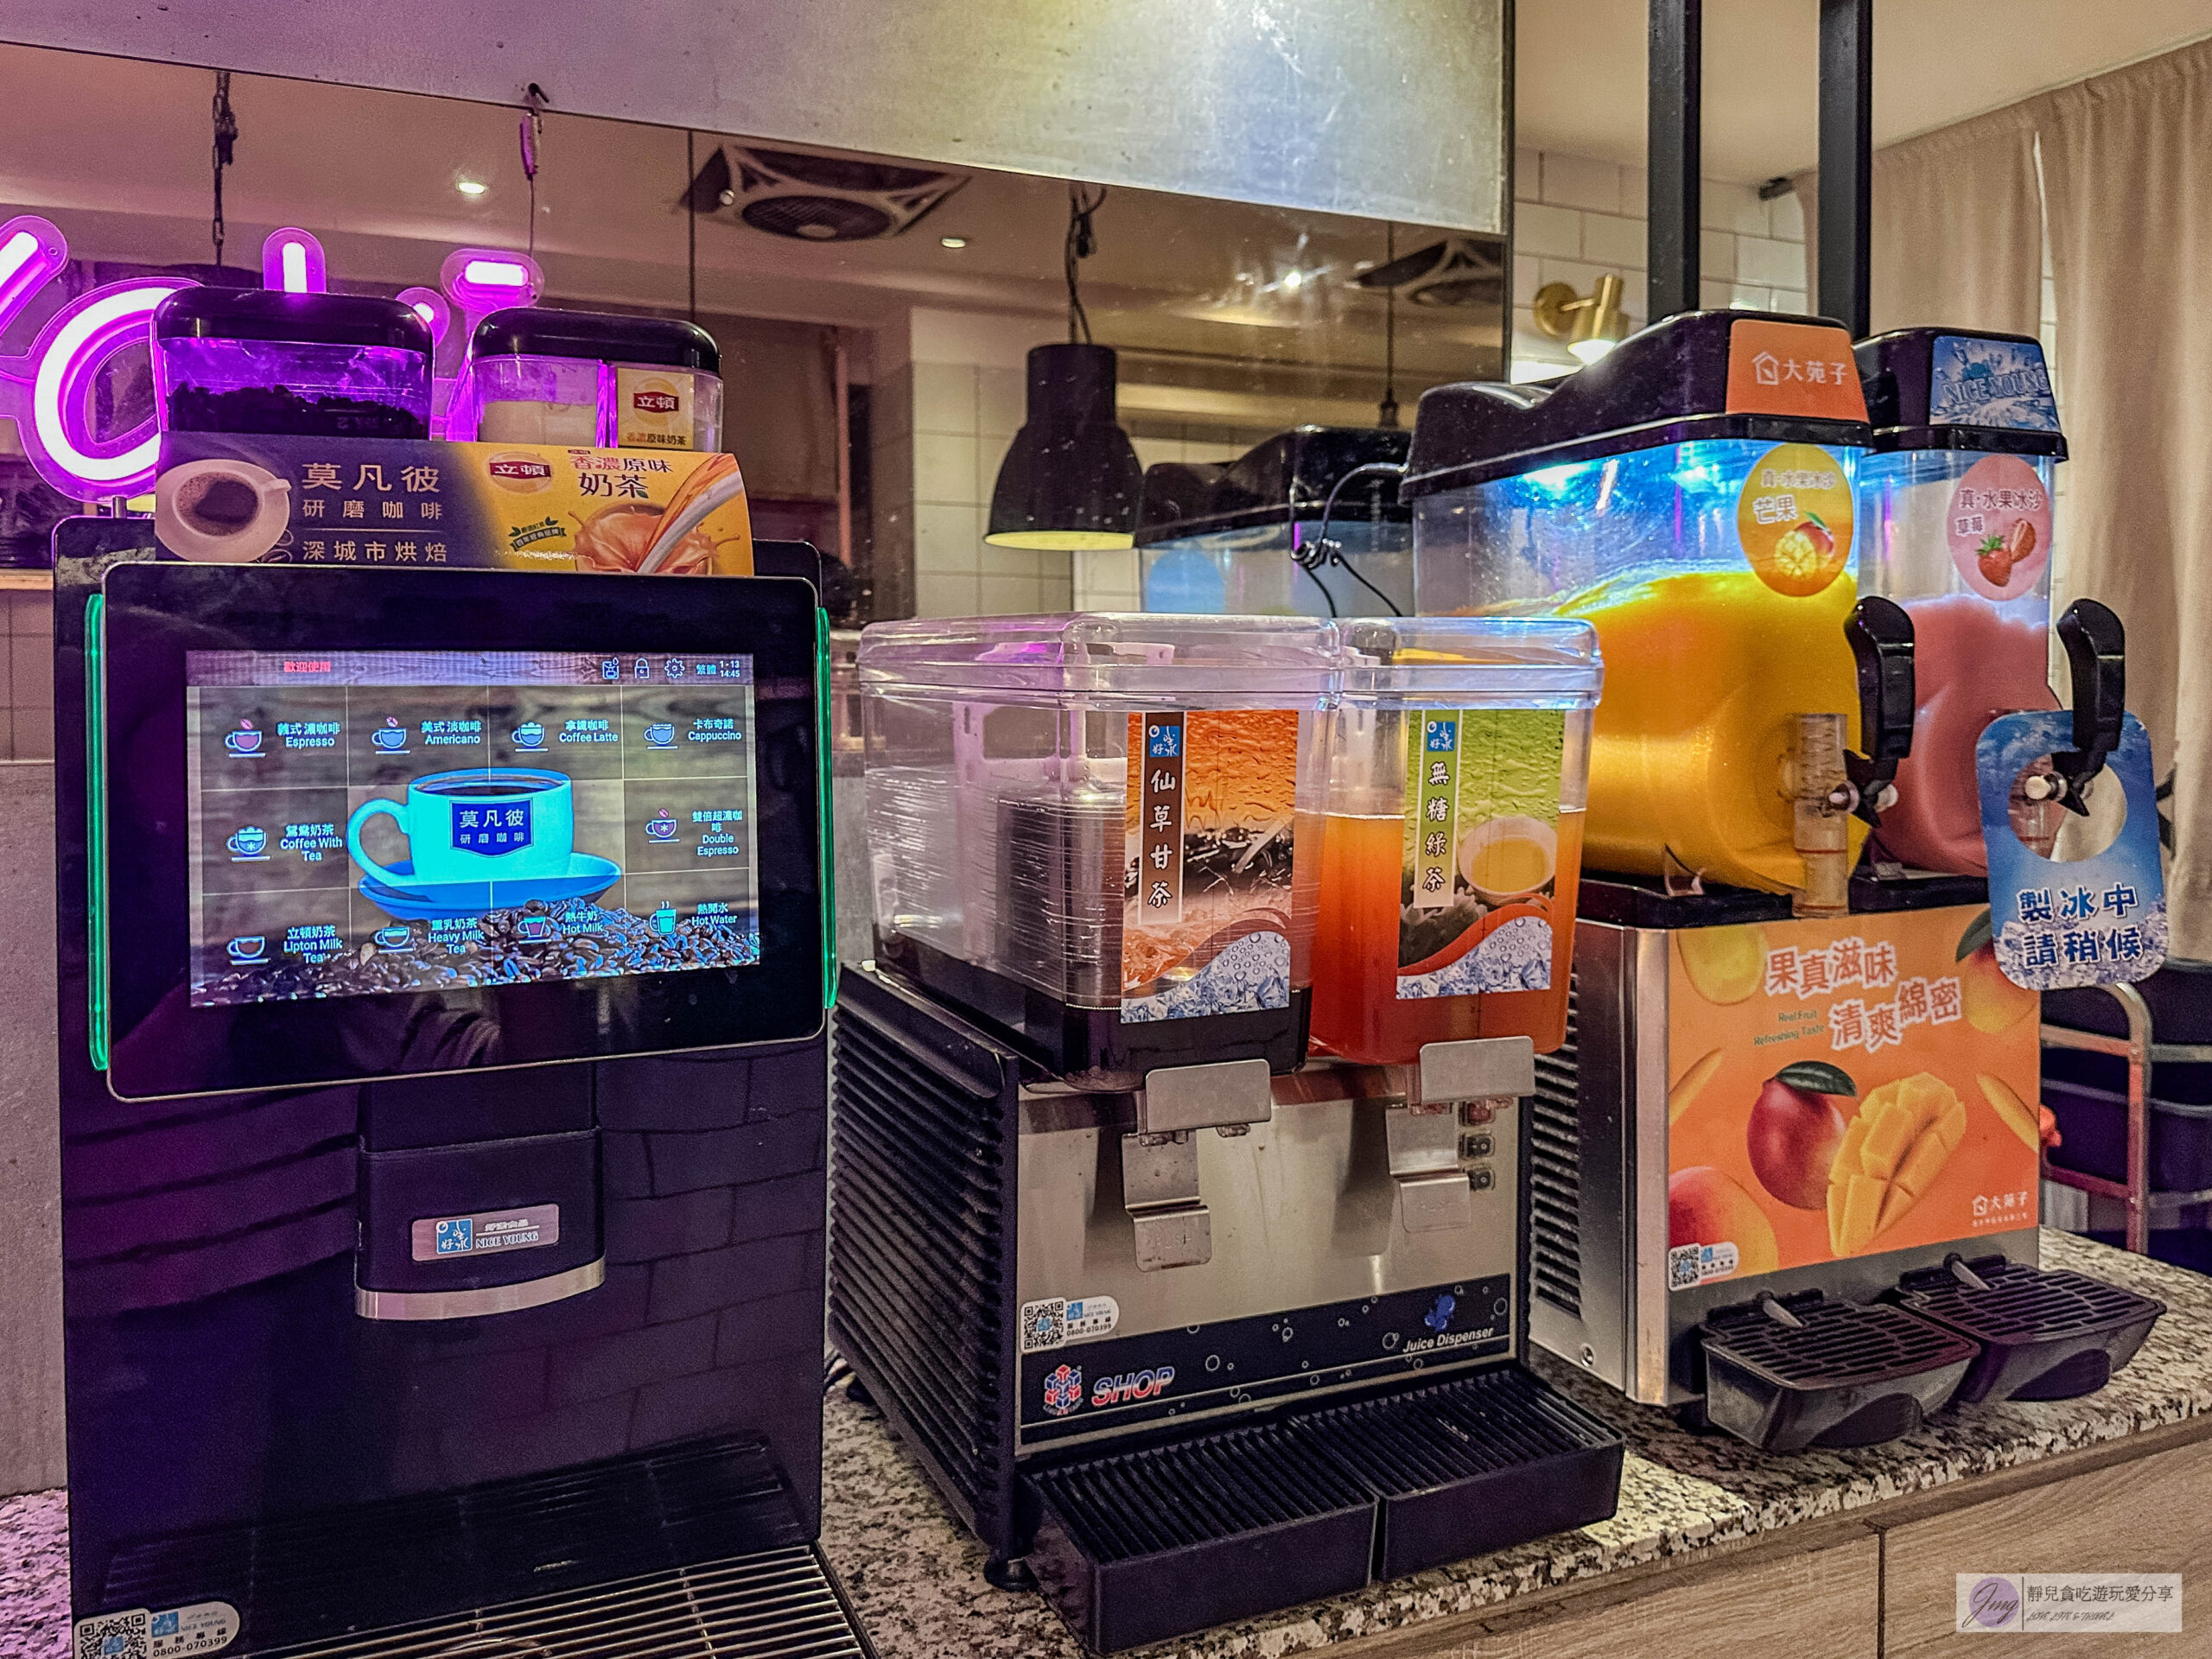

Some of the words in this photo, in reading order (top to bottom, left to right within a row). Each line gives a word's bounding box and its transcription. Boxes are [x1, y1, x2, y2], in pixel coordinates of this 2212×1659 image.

[1783, 359, 1847, 385] 大苑子
[1942, 378, 1989, 404] NICE
[637, 396, 676, 410] 立頓
[494, 464, 545, 477] 立頓
[570, 456, 674, 474] 香濃原味
[302, 463, 441, 493] 莫凡彼
[578, 473, 648, 499] 奶茶
[302, 499, 442, 520] 研磨咖啡
[1753, 494, 1797, 524] 芒果
[302, 540, 448, 563] 深城市烘焙
[719, 670, 741, 678] 14:45
[285, 737, 335, 750] Espresso
[425, 734, 481, 745] Americano
[559, 732, 592, 743] Coffee
[594, 732, 619, 742] Latte
[688, 730, 742, 743] Cappuccino
[460, 809, 525, 829] 莫凡彼
[1422, 761, 1450, 893] 無糖綠茶
[280, 837, 317, 850] Coffee
[318, 836, 343, 849] With
[460, 831, 525, 845] 研磨咖啡
[702, 833, 734, 844] Double
[1147, 768, 1176, 909] 仙草甘茶
[302, 850, 322, 862] Tea
[697, 846, 740, 858] Espresso
[2017, 882, 2139, 923] 製冰中
[563, 923, 581, 934] Hot
[582, 922, 603, 933] Milk
[691, 915, 709, 926] Hot
[709, 914, 738, 925] Water
[287, 925, 336, 940] 立頓奶茶
[428, 932, 460, 944] Heavy
[461, 929, 484, 941] Milk
[283, 940, 317, 954] Lipton
[319, 938, 343, 950] Milk
[446, 944, 467, 955] Tea
[2023, 925, 2144, 968] 請稍候
[302, 952, 323, 964] Tea
[1765, 938, 1897, 999] 果真滋味
[1777, 1012, 1796, 1022] Real
[1798, 1009, 1818, 1020] Fruit
[1830, 978, 1961, 1052] 清爽綿密
[1753, 1030, 1799, 1046] Refreshing
[1802, 1024, 1825, 1035] Taste
[475, 1236, 501, 1249] NICE
[502, 1230, 540, 1246] YOUNG
[1402, 1338, 1435, 1354] Juice
[1436, 1327, 1494, 1348] Dispenser
[1091, 1366, 1175, 1407] SHOP
[153, 1636, 228, 1657] 0800-070399
